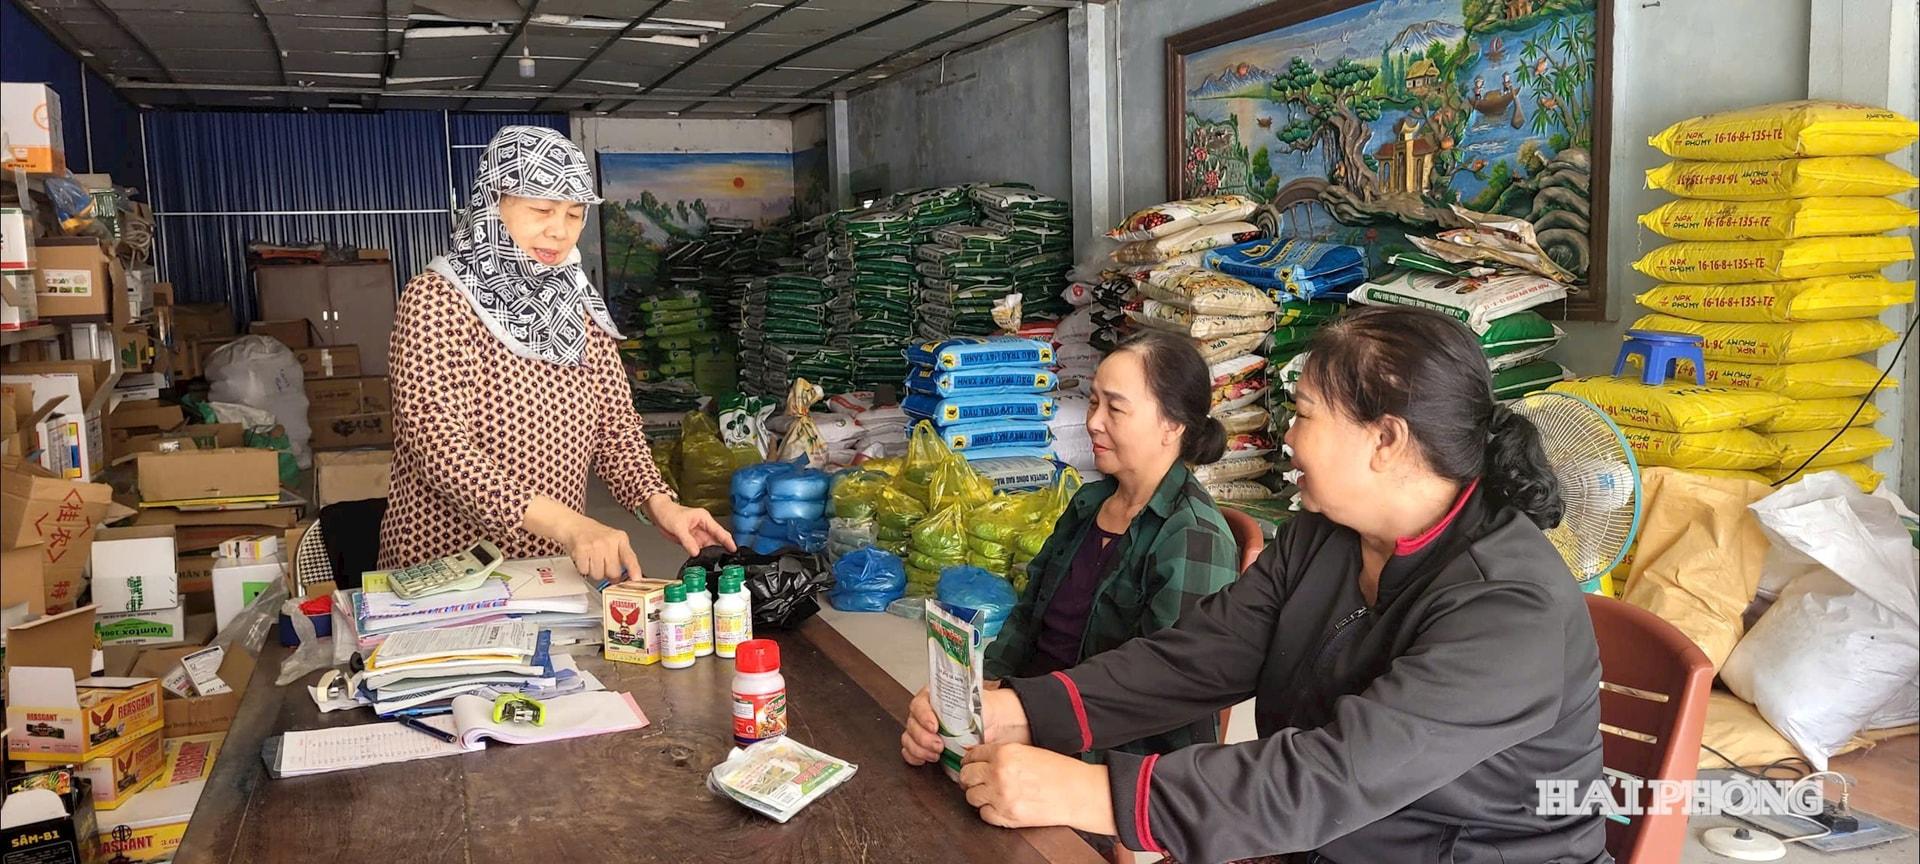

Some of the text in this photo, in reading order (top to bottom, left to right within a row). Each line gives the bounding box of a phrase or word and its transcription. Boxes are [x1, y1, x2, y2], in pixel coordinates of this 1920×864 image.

[1749, 178, 1768, 186] NPK
[1669, 258, 1687, 266] NPK
[1210, 339, 1228, 350] NPK
[1730, 379, 1750, 387] NPK
[1630, 441, 1649, 449] NPK
[121, 626, 168, 637] Wamtox
[118, 693, 155, 719] REASGANT
[11, 830, 60, 848] SÂM-B1
